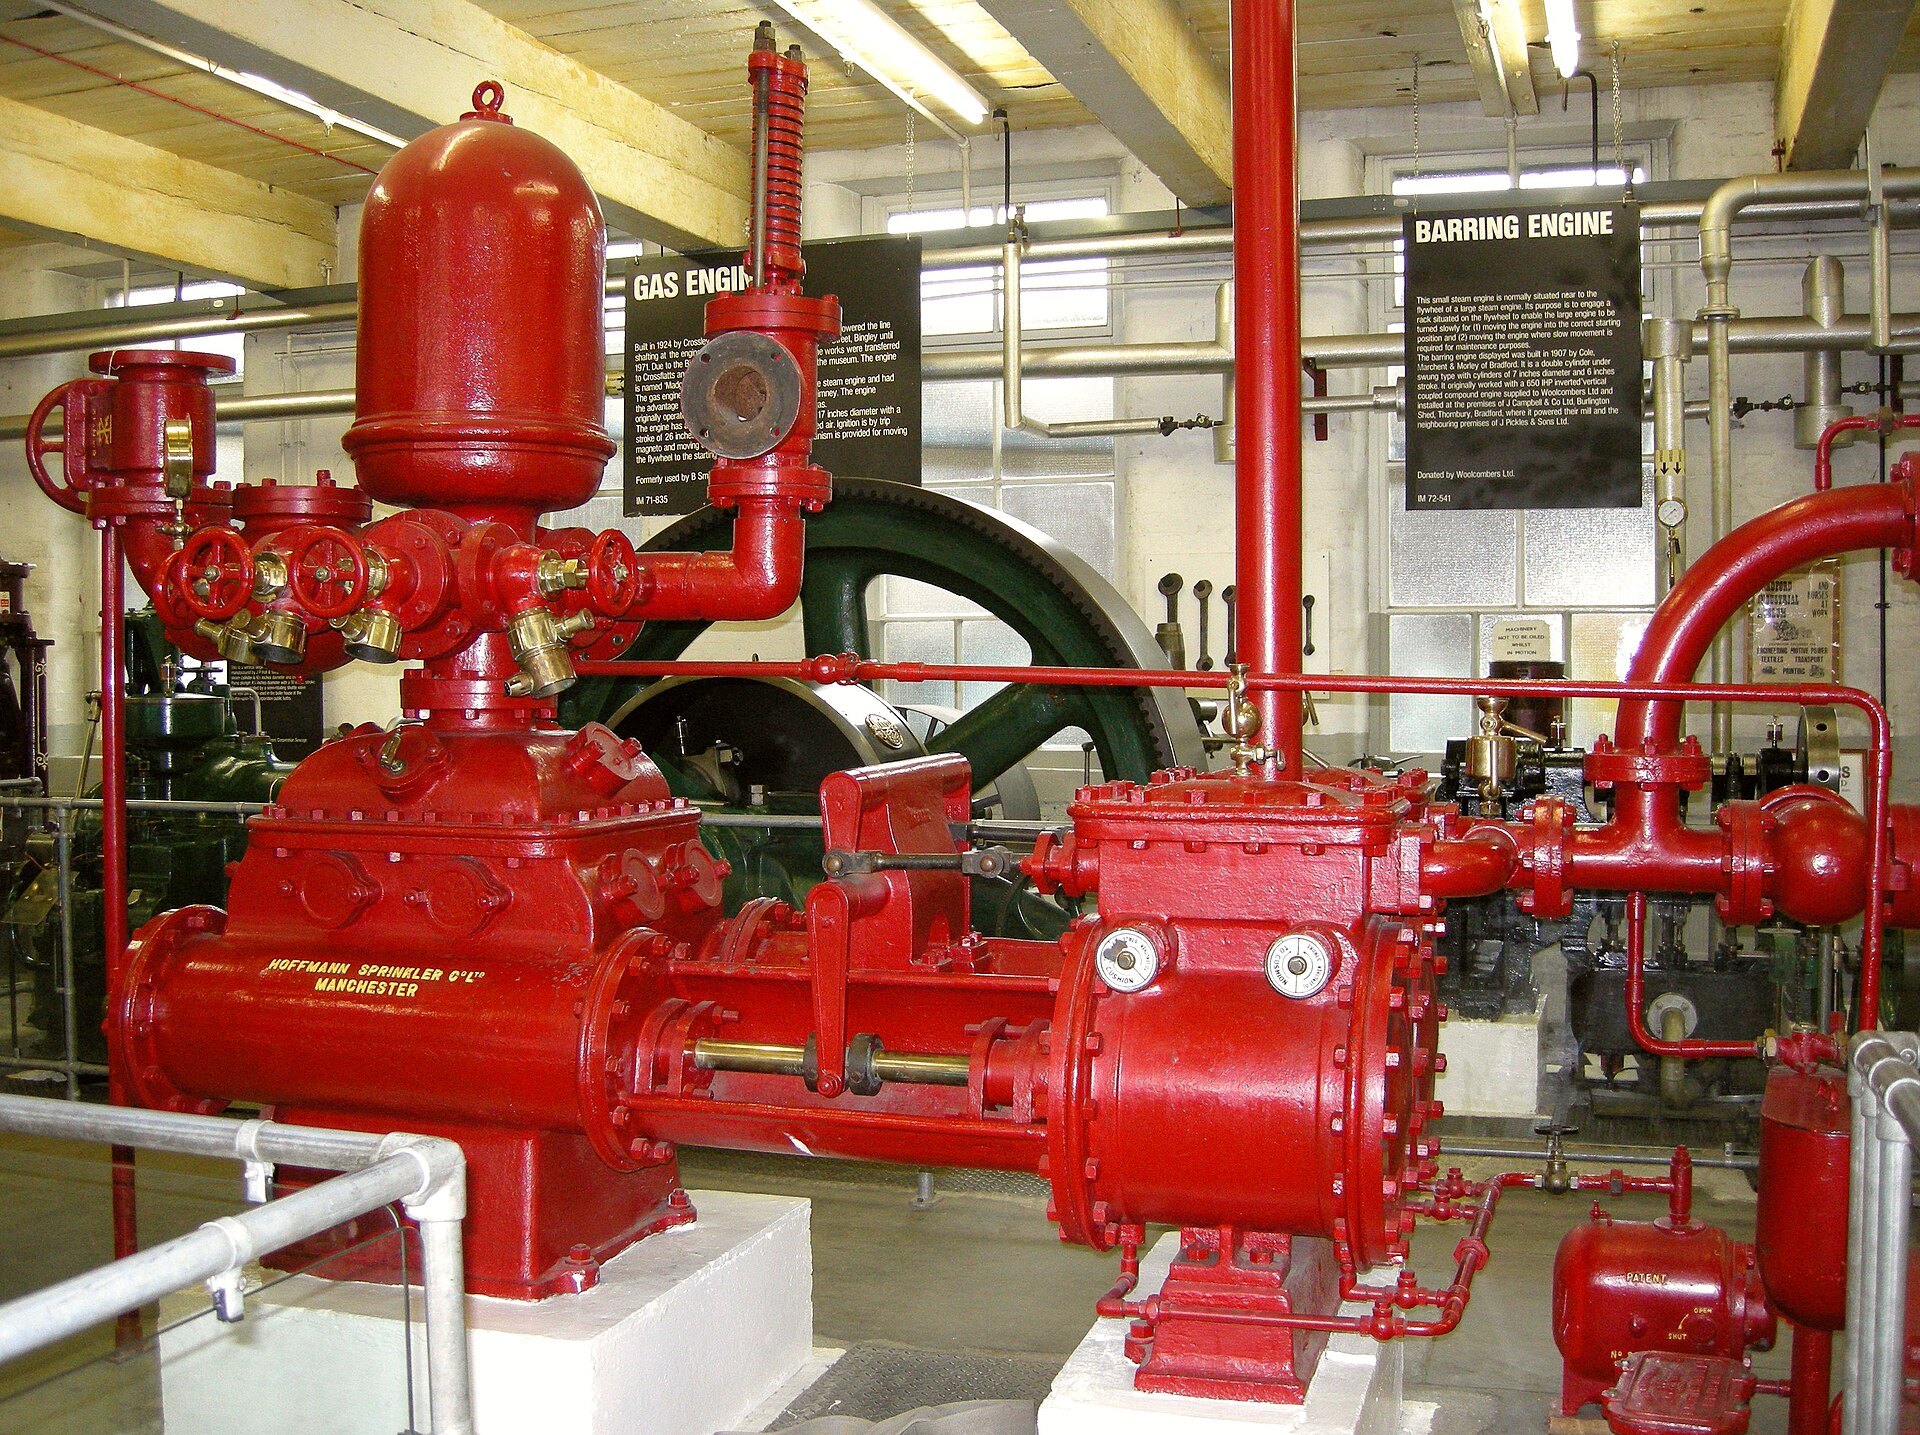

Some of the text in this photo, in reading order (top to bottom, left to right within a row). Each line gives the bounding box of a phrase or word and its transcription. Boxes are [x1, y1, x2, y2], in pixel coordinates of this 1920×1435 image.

[1415, 211, 1613, 243] BARRING ENGINE
[633, 265, 752, 301] GAS ENGIN
[1417, 296, 1430, 304] This
[1432, 295, 1449, 303] small
[1451, 294, 1471, 303] steam
[1473, 293, 1494, 304] engine
[1496, 293, 1502, 301] is
[1504, 292, 1531, 303] normally
[1534, 291, 1559, 300] situated
[1578, 290, 1585, 298] to
[1587, 290, 1597, 298] the
[867, 322, 878, 331] the
[880, 320, 890, 330] line
[1417, 324, 1438, 333] turned
[1440, 324, 1460, 334] slowly
[1462, 323, 1471, 331] for
[1483, 322, 1506, 332] moving
[1509, 322, 1519, 330] the
[1521, 321, 1542, 331] engine
[1544, 320, 1556, 328] into
[1558, 320, 1569, 328] the
[1571, 319, 1594, 327] correct
[1596, 318, 1620, 328] starting
[854, 331, 893, 344] Bingley until
[635, 342, 648, 352] Built
[650, 342, 655, 350] in
[657, 340, 672, 350] 1924
[674, 339, 682, 350] by
[824, 341, 900, 356] works were transferred
[635, 350, 679, 364] shafting at the
[861, 354, 873, 364] The
[875, 352, 896, 364] engine
[652, 362, 663, 371] Due
[665, 361, 672, 369] to
[673, 360, 683, 369] the
[635, 371, 675, 382] to Crossflatts
[823, 374, 894, 388] steam engine and had
[635, 382, 662, 392] is named
[841, 386, 876, 397] The engine
[636, 394, 647, 402] The
[649, 394, 660, 403] gas
[636, 401, 678, 414] the advantage
[817, 406, 901, 420] 17 inches diameter with a
[635, 413, 661, 425] originally
[837, 419, 860, 430] Ignition
[862, 418, 867, 427] is
[869, 417, 878, 428] by
[880, 416, 890, 428] trip
[1418, 420, 1458, 430] neighbouring
[1460, 419, 1489, 429] premises
[1500, 418, 1504, 426] J
[1506, 418, 1528, 426] Pickles
[1530, 418, 1535, 426] &
[1538, 417, 1554, 425] Sons
[636, 422, 682, 434] The engine has
[835, 426, 907, 440] is provided for moving
[636, 434, 655, 443] stroke
[656, 433, 662, 442] of
[665, 432, 674, 441] 26
[636, 441, 701, 455] magneto and moving
[636, 450, 718, 465] the flywheel to the starting
[636, 473, 696, 486] Formerly used by B
[1418, 471, 1444, 479] Donated
[1446, 471, 1454, 480] by
[1456, 470, 1501, 478] Woolcombers
[636, 495, 668, 505] IM 71-835
[1418, 494, 1450, 502] IM 72-541
[268, 958, 350, 975] HOFFMANN
[358, 964, 443, 981] SPRINKLER
[1274, 945, 1288, 985] TO CUSHION
[1105, 966, 1134, 983] CUSHION
[314, 978, 418, 997] MANCHESTER
[1626, 1272, 1667, 1284] PATENT
